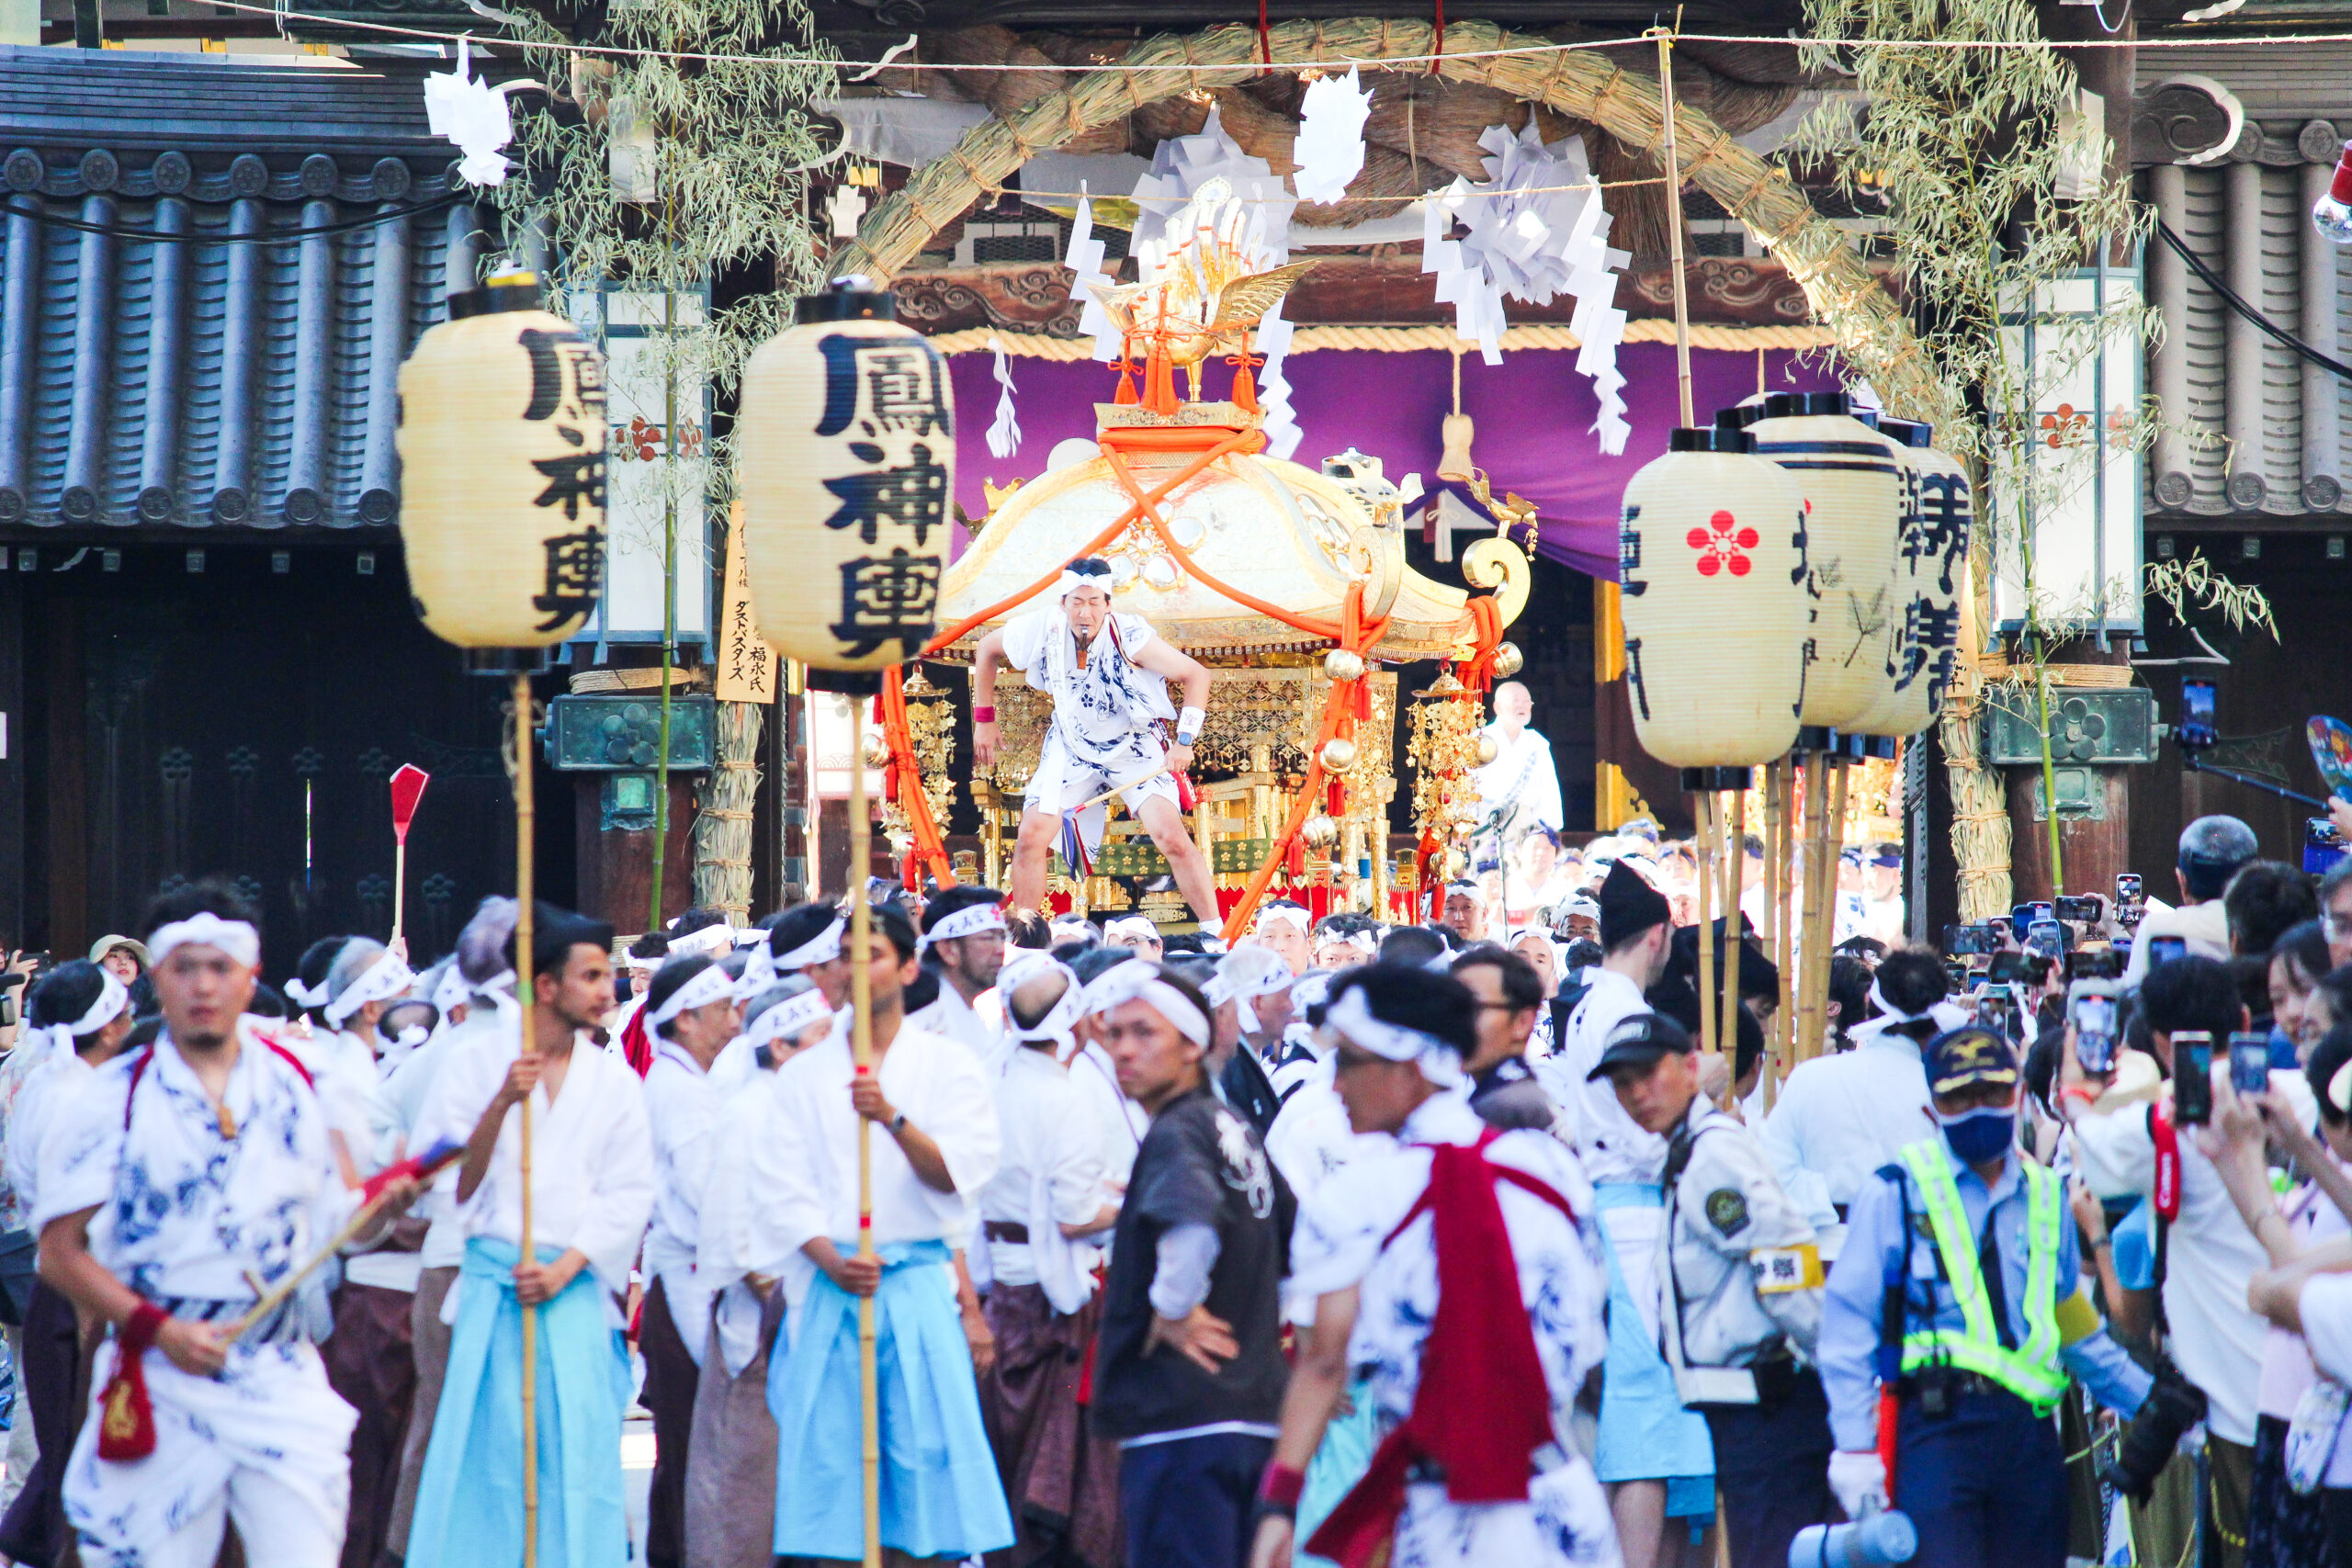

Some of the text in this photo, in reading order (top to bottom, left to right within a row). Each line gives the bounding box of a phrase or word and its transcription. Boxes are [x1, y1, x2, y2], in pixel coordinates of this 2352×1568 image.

[729, 600, 750, 682] ダストバスターズ
[747, 647, 766, 694] 福永氏
